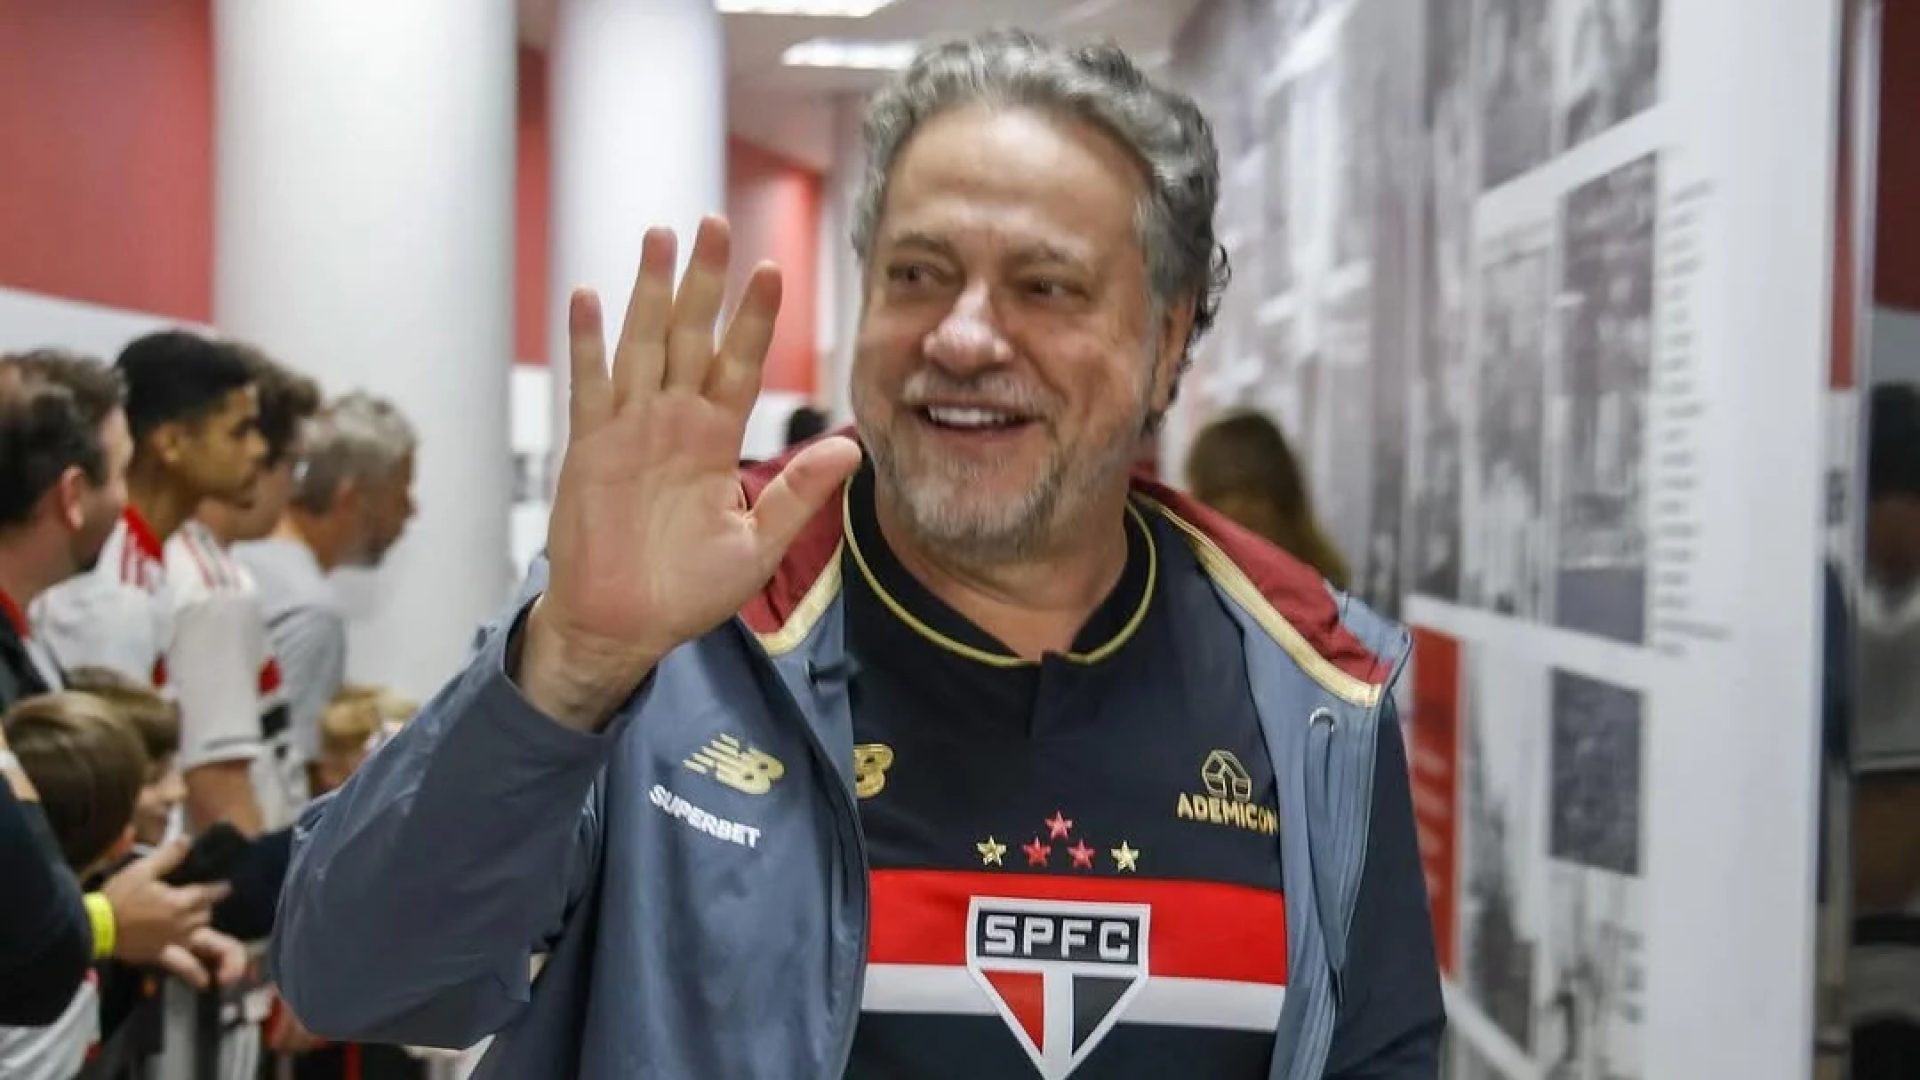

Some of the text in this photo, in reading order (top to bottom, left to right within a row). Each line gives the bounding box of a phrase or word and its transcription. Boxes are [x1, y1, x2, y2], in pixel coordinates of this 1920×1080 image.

[648, 778, 761, 849] SUPERBET
[1177, 792, 1279, 836] ADEMICON
[984, 914, 1130, 960] SPFC
